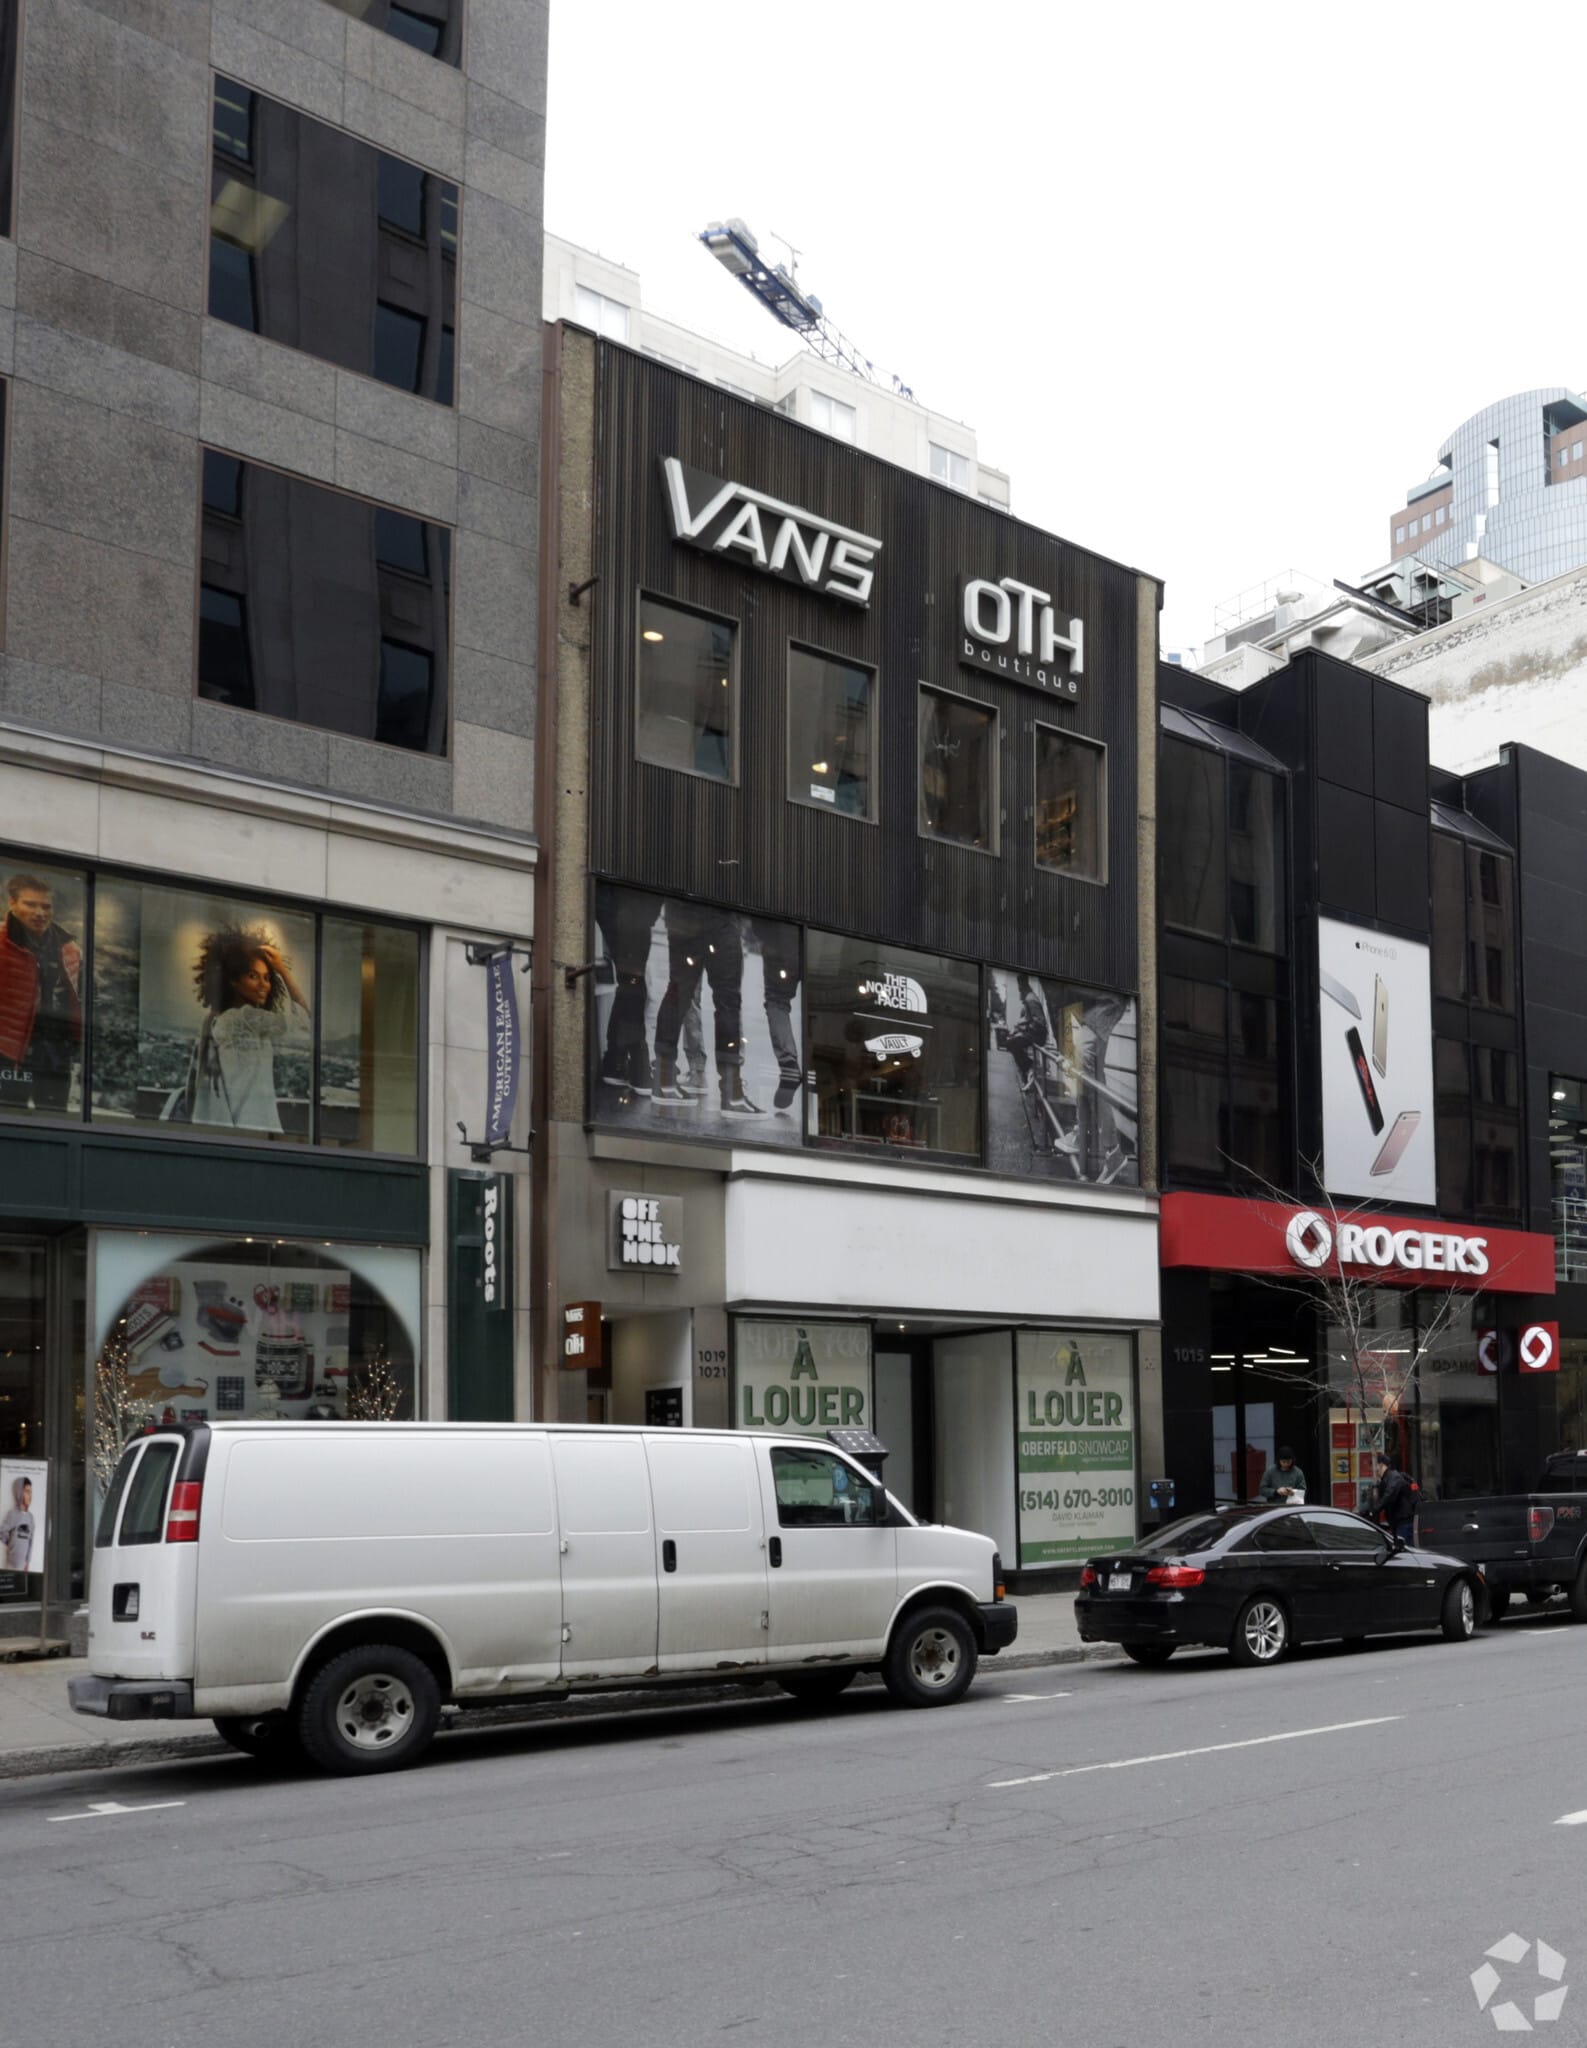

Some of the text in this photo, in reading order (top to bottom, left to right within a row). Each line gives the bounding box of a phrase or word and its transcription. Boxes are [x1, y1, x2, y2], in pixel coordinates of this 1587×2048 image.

[664, 457, 882, 602] VANS
[964, 577, 1083, 675] OTH
[964, 638, 1077, 693] boutique
[866, 980, 906, 998] NORTH
[884, 972, 907, 987] THE
[878, 995, 907, 1010] FACE
[491, 964, 505, 1132] AMERICAN EAGLE
[503, 999, 512, 1097] OUTFITTERS
[880, 1036, 908, 1050] VAULT
[0, 1069, 33, 1082] GLE
[621, 1198, 659, 1220] OFF
[622, 1220, 664, 1243] THE
[485, 1186, 498, 1303] Roots
[623, 1240, 681, 1266] HOOK
[1337, 1223, 1489, 1275] ROGERS
[565, 1333, 584, 1355] OTH
[790, 1328, 819, 1380] À
[1173, 1347, 1205, 1363] 1015
[699, 1350, 726, 1363] 1019
[1065, 1340, 1087, 1386] À
[699, 1365, 727, 1378] 1021
[743, 1385, 865, 1426] LOUER
[1028, 1390, 1123, 1426] LOUER
[1020, 1488, 1133, 1511] (514) 670-3010
[1052, 1512, 1073, 1522] DAVID
